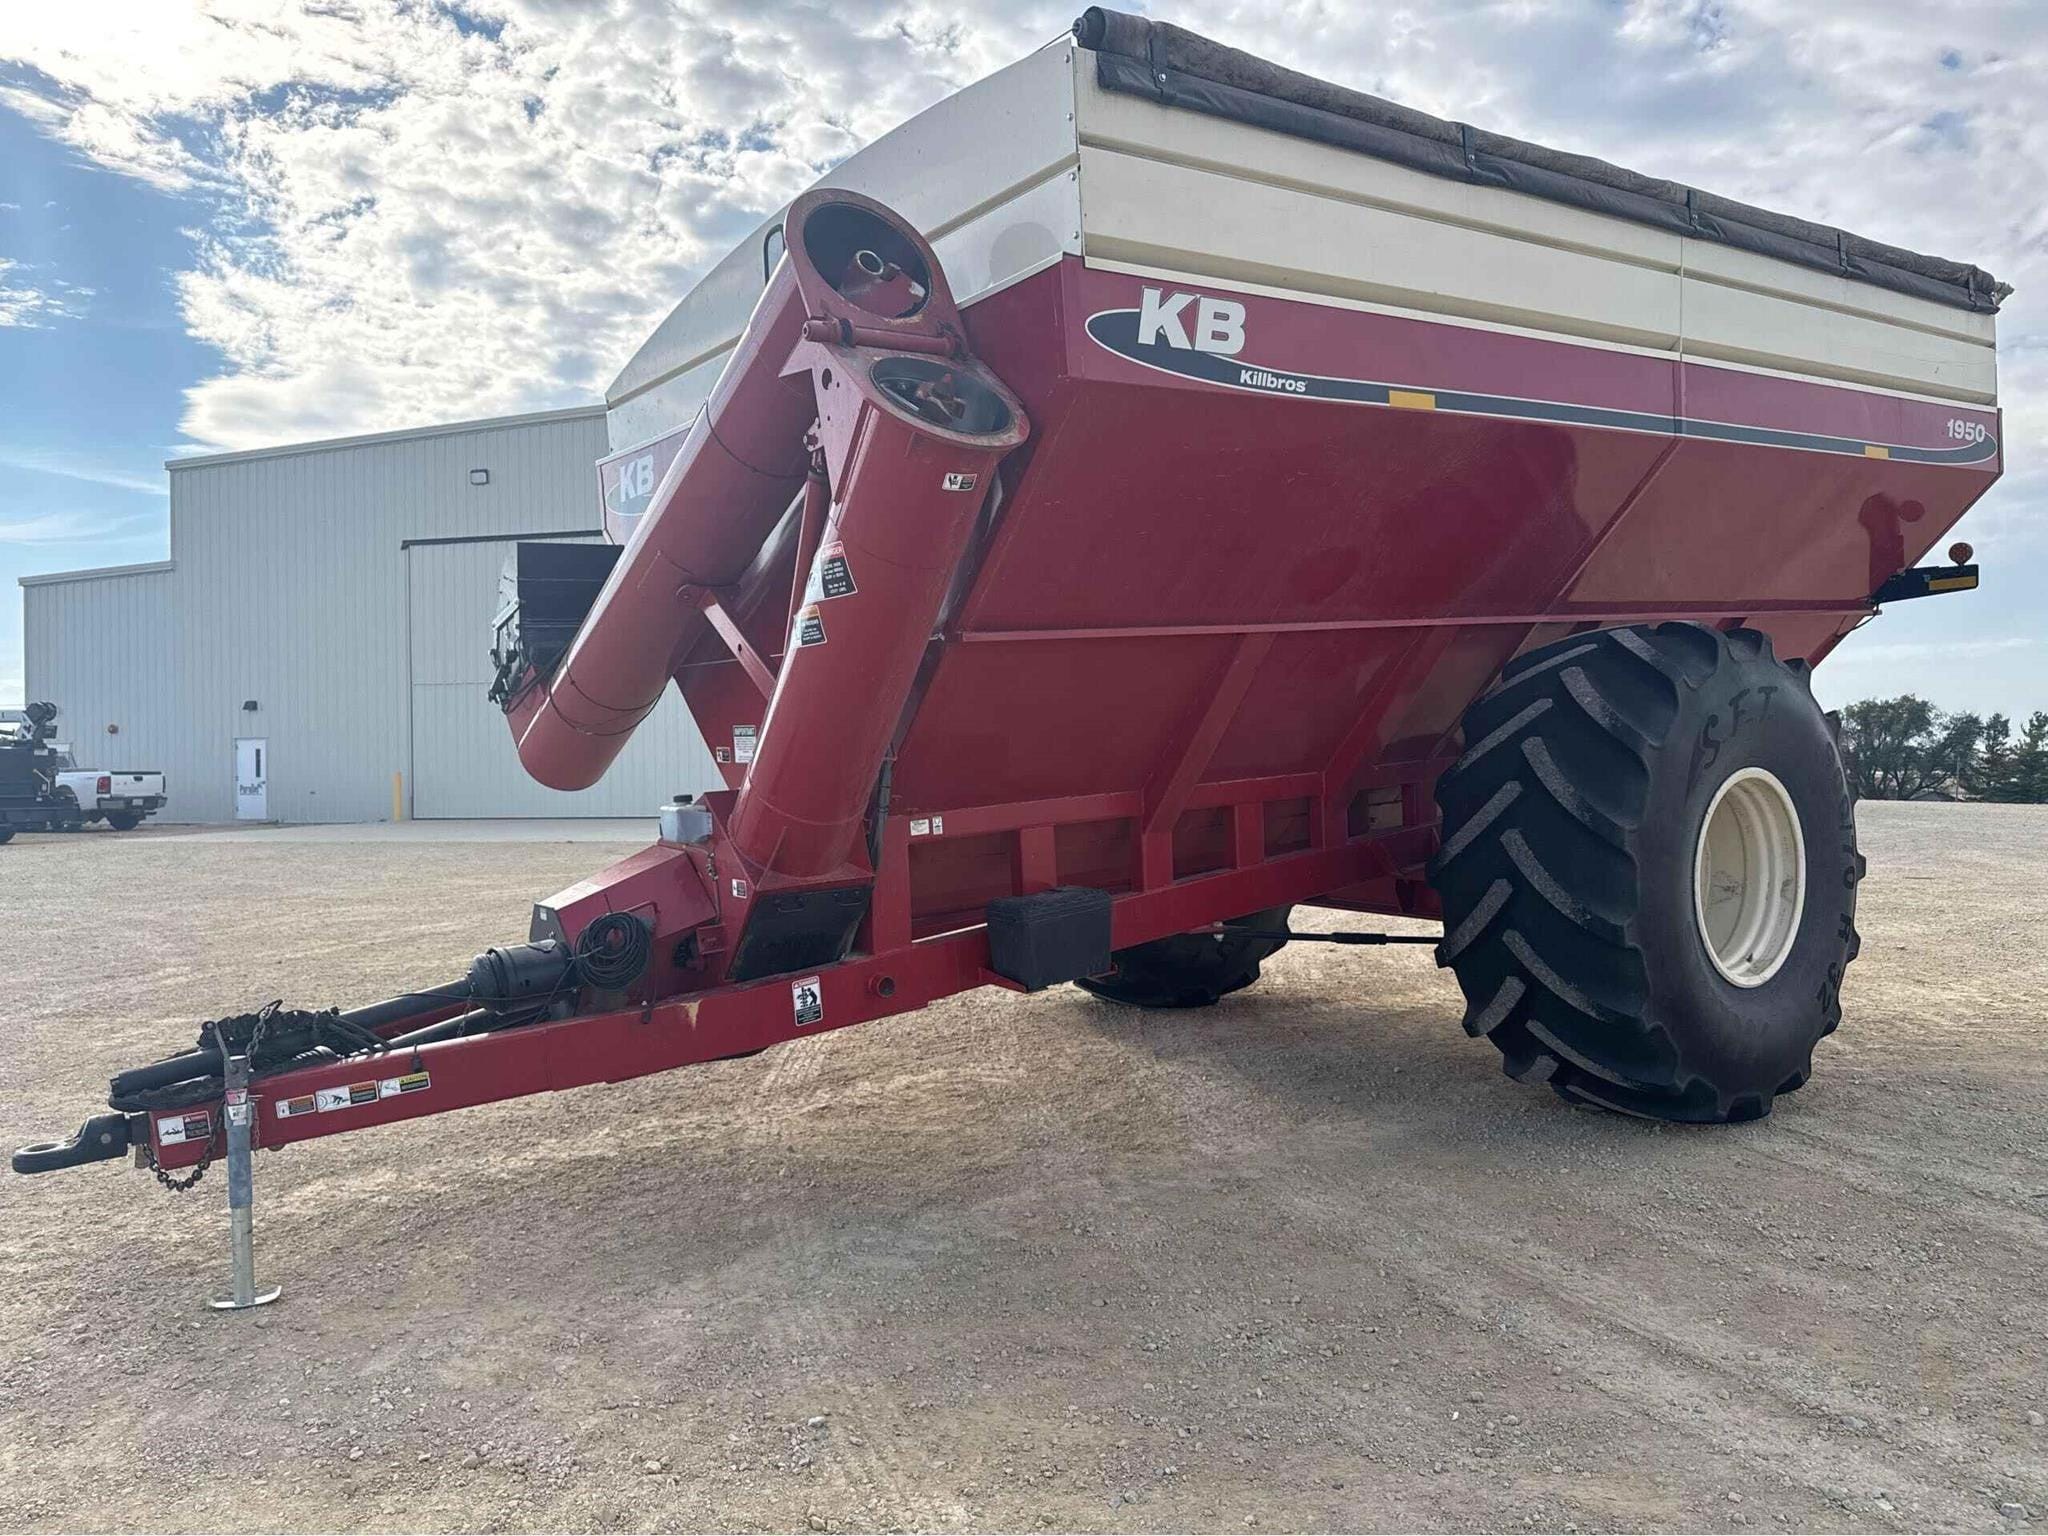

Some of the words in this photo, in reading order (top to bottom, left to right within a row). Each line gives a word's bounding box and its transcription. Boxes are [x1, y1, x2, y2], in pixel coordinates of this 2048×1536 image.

[1137, 285, 1246, 355] KB
[1239, 369, 1307, 393] Killbros
[1946, 418, 1986, 443] 1950
[619, 454, 655, 503] KB
